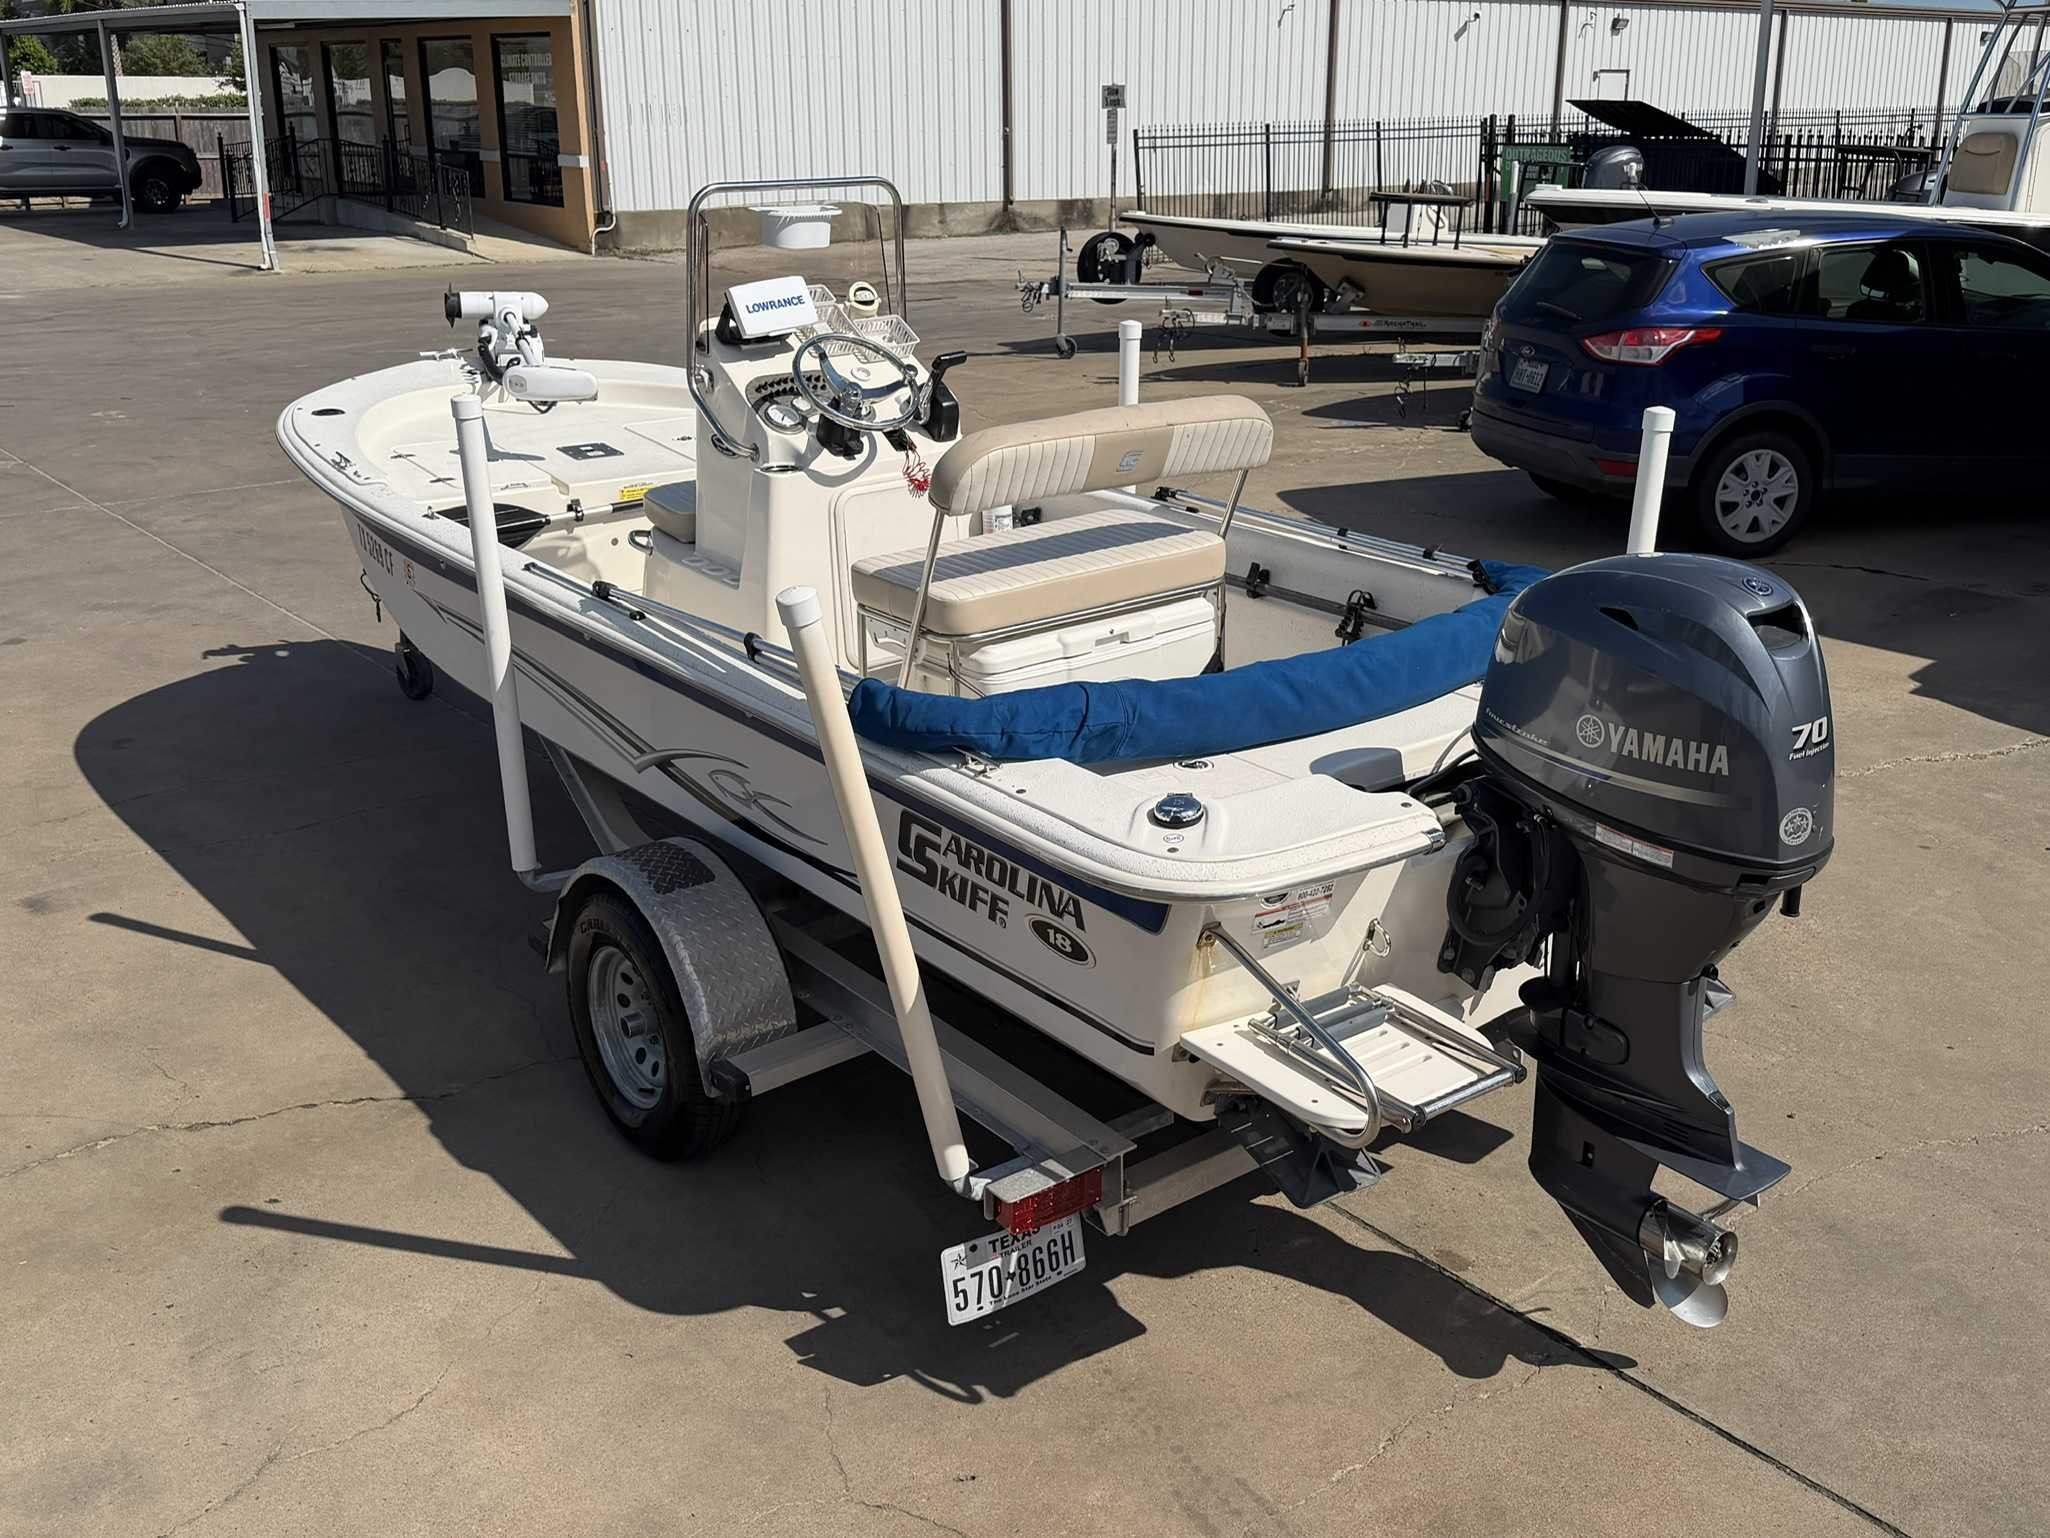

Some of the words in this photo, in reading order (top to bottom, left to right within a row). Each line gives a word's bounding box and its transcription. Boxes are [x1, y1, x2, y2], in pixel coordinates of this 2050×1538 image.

[1505, 147, 1568, 161] OUTRAGEOUS
[745, 295, 806, 314] LOWRANCE
[1791, 716, 1828, 750] 70
[1608, 722, 1729, 776] YAMAHA
[896, 832, 1010, 923] SKIFF
[898, 808, 1087, 933] CAROLINA
[1046, 928, 1073, 953] 18
[1000, 1238, 1033, 1258] TRAILER
